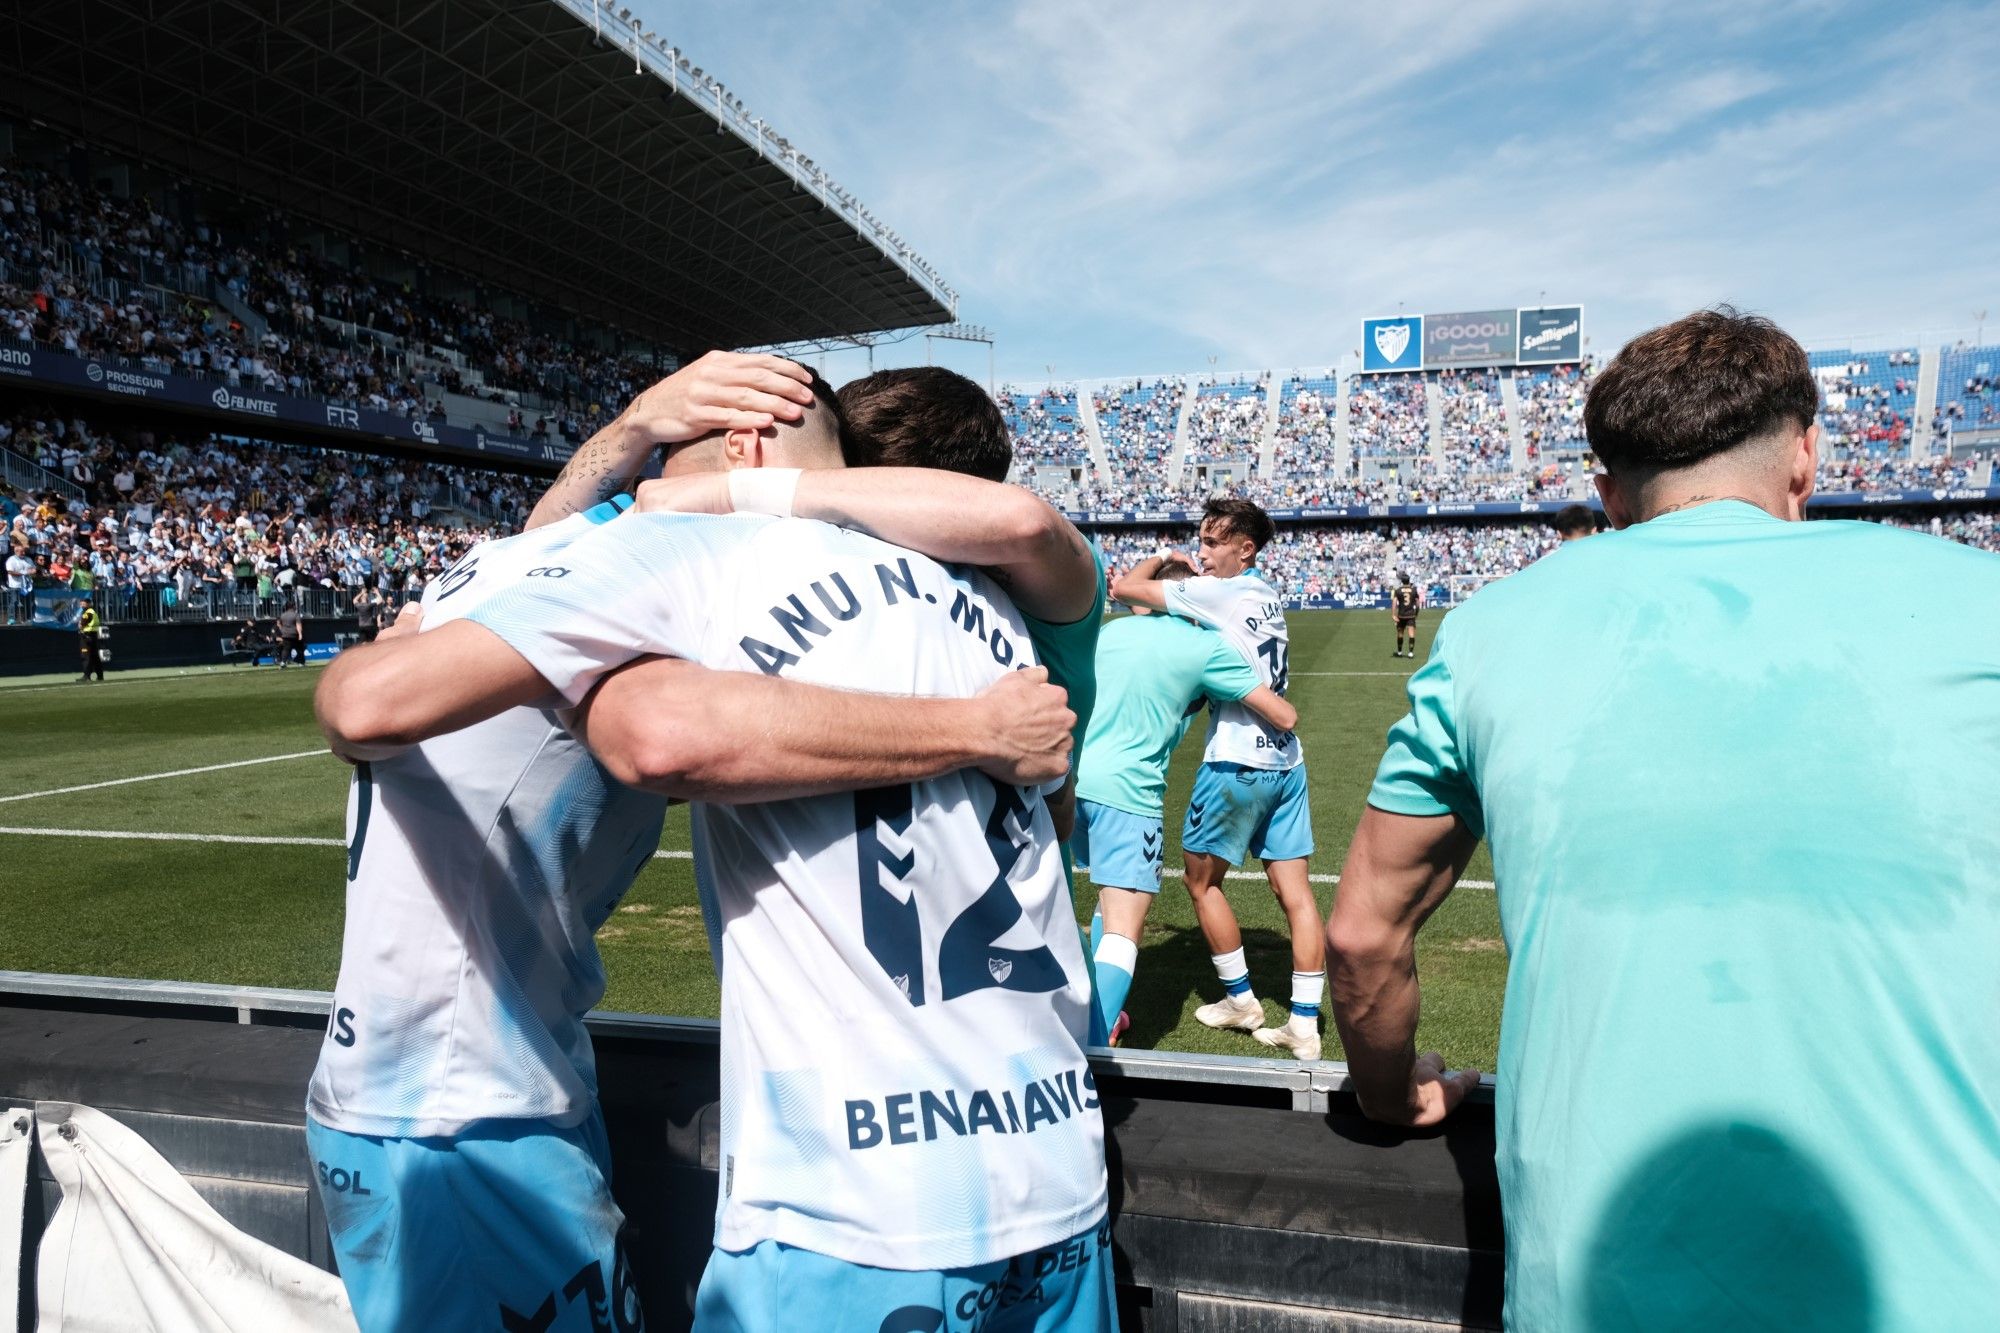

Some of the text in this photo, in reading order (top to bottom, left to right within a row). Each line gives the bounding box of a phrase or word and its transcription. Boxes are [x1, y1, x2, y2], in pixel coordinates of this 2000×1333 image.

[106, 370, 165, 390] PROSEGUR
[107, 382, 147, 396] SECURITY
[326, 405, 360, 427] FTR
[412, 421, 435, 438] Olin
[1348, 592, 1382, 602] vihas
[873, 557, 938, 606] N.
[949, 588, 1031, 672] MO
[1245, 616, 1263, 632] D.
